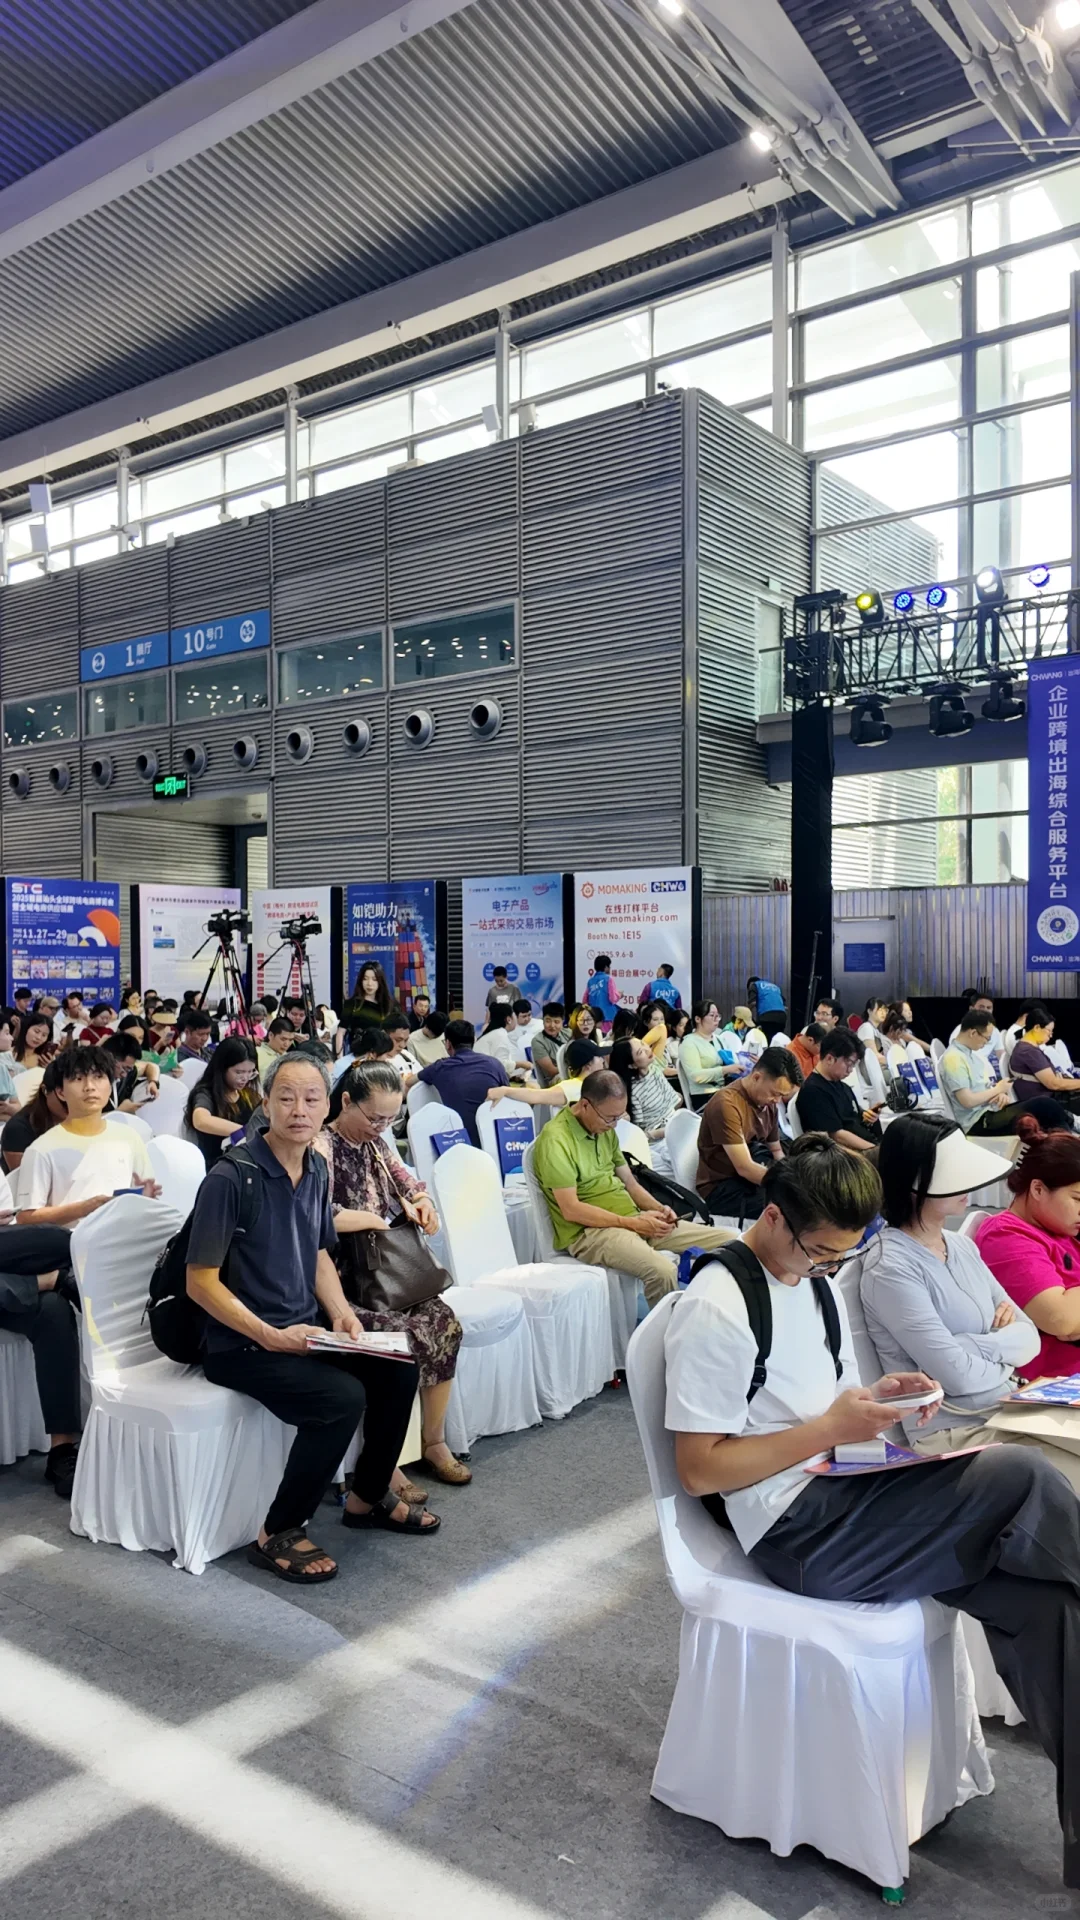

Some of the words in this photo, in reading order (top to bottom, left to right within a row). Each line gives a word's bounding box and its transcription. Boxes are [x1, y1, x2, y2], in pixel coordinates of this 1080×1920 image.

[184, 629, 204, 655] 10
[125, 645, 134, 667] 1
[1048, 684, 1068, 899] 企业跨境出海综合服务平台
[12, 882, 43, 894] STC
[597, 883, 648, 895] MOMAKING
[352, 902, 398, 919] 如铠助力
[492, 899, 529, 912] 电子产品
[605, 903, 659, 914] 在线打样平台
[470, 917, 554, 930] 一站式采购交易市场
[587, 913, 678, 924] www.momaking.com
[352, 920, 399, 938] 出海无忧
[622, 931, 641, 940] 1E15
